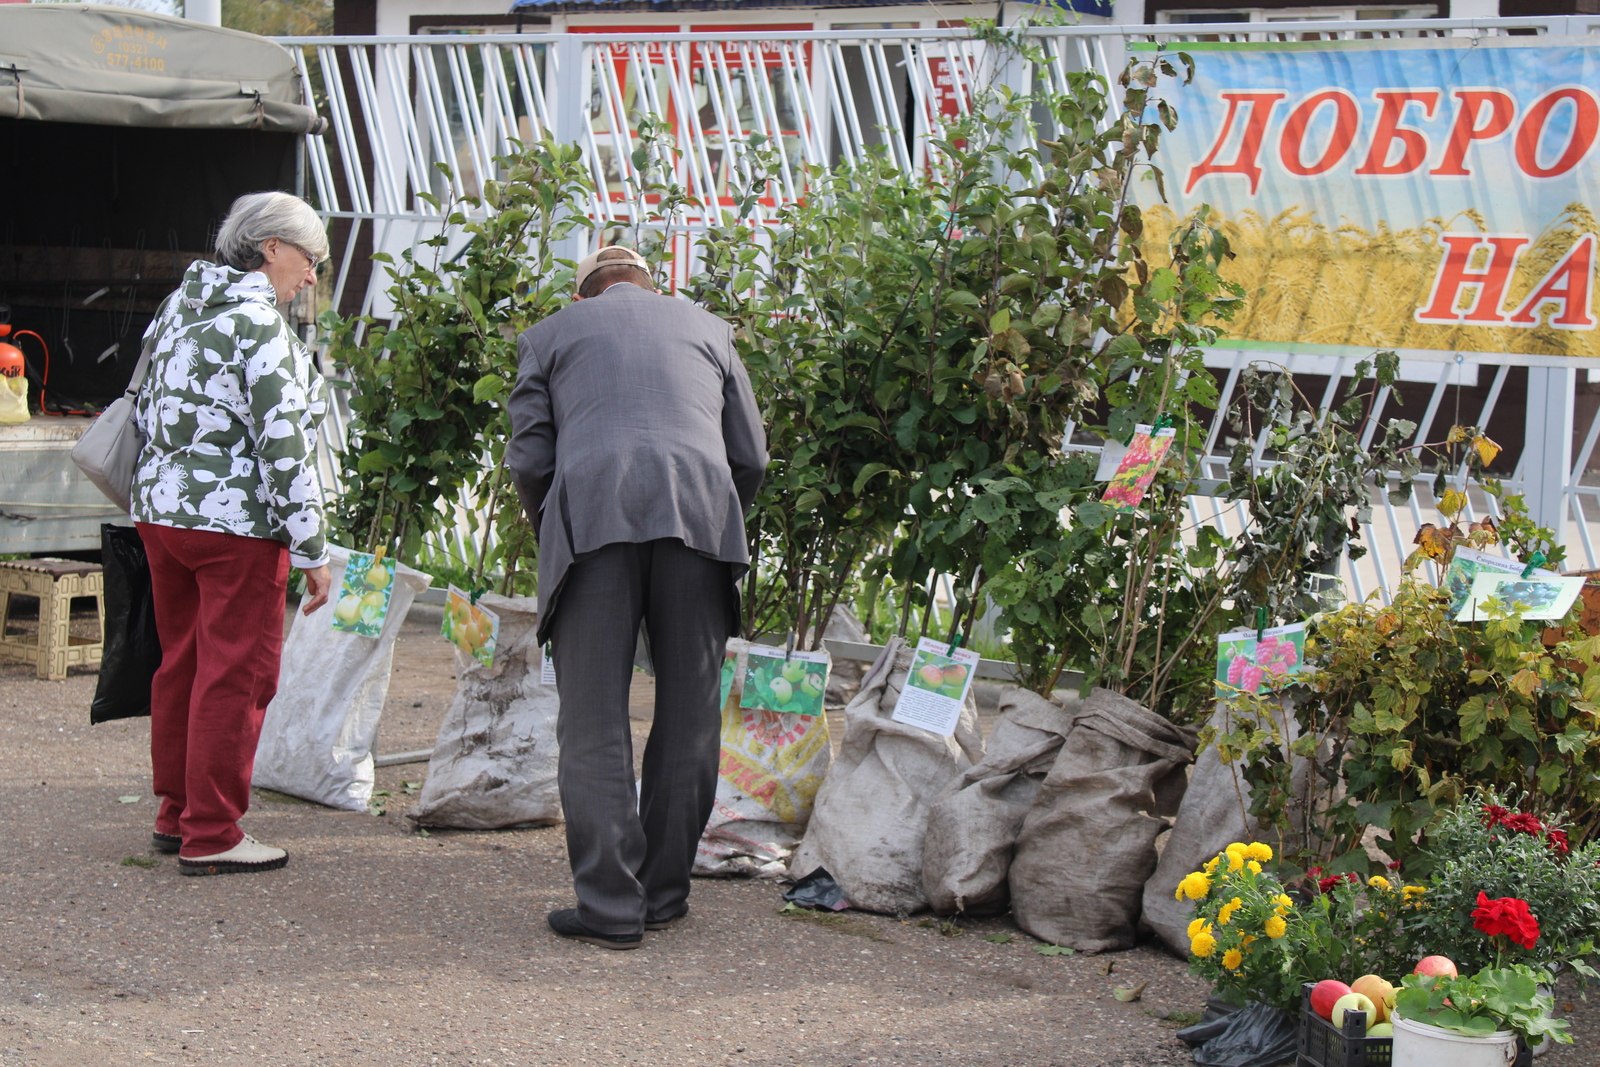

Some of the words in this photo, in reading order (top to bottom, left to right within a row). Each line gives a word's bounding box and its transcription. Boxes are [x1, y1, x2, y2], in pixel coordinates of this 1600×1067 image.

[118, 41, 148, 55] (032)
[107, 52, 165, 71] 577-4100
[1185, 88, 1600, 195] ДОБРО
[1420, 236, 1593, 325] НА
[1476, 555, 1508, 569] Смородина
